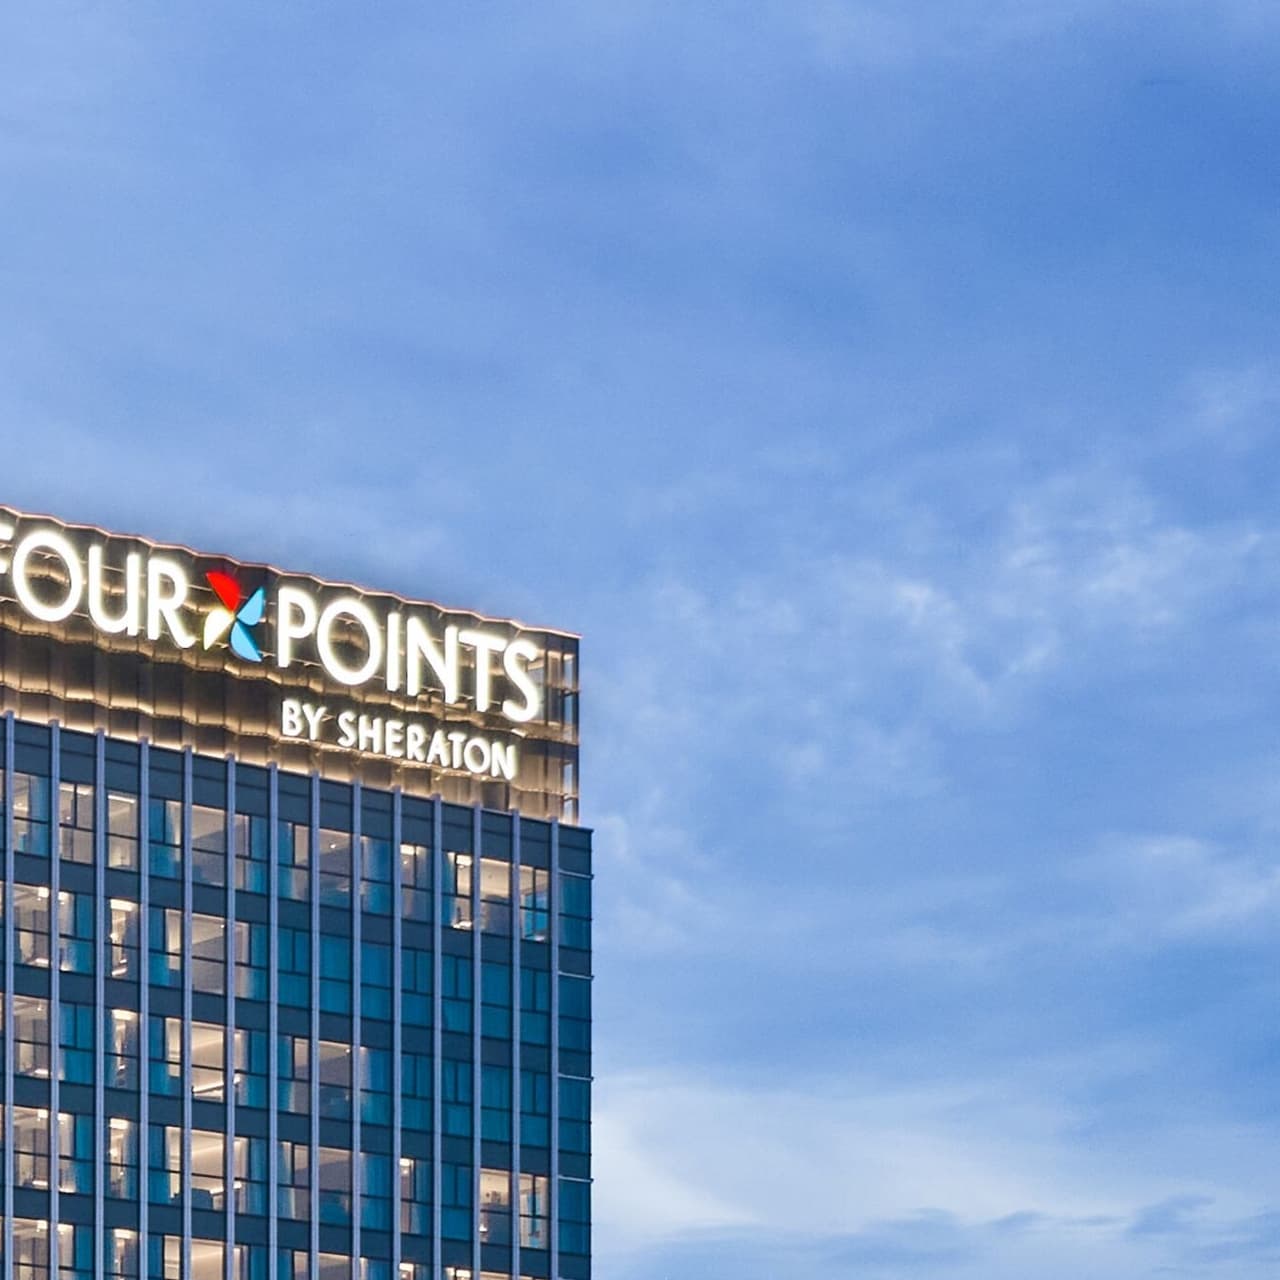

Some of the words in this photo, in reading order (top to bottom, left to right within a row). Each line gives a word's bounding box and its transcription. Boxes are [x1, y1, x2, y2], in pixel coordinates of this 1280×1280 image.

[276, 585, 539, 722] POINTS
[281, 699, 324, 741] BY
[337, 712, 519, 780] SHERATON
